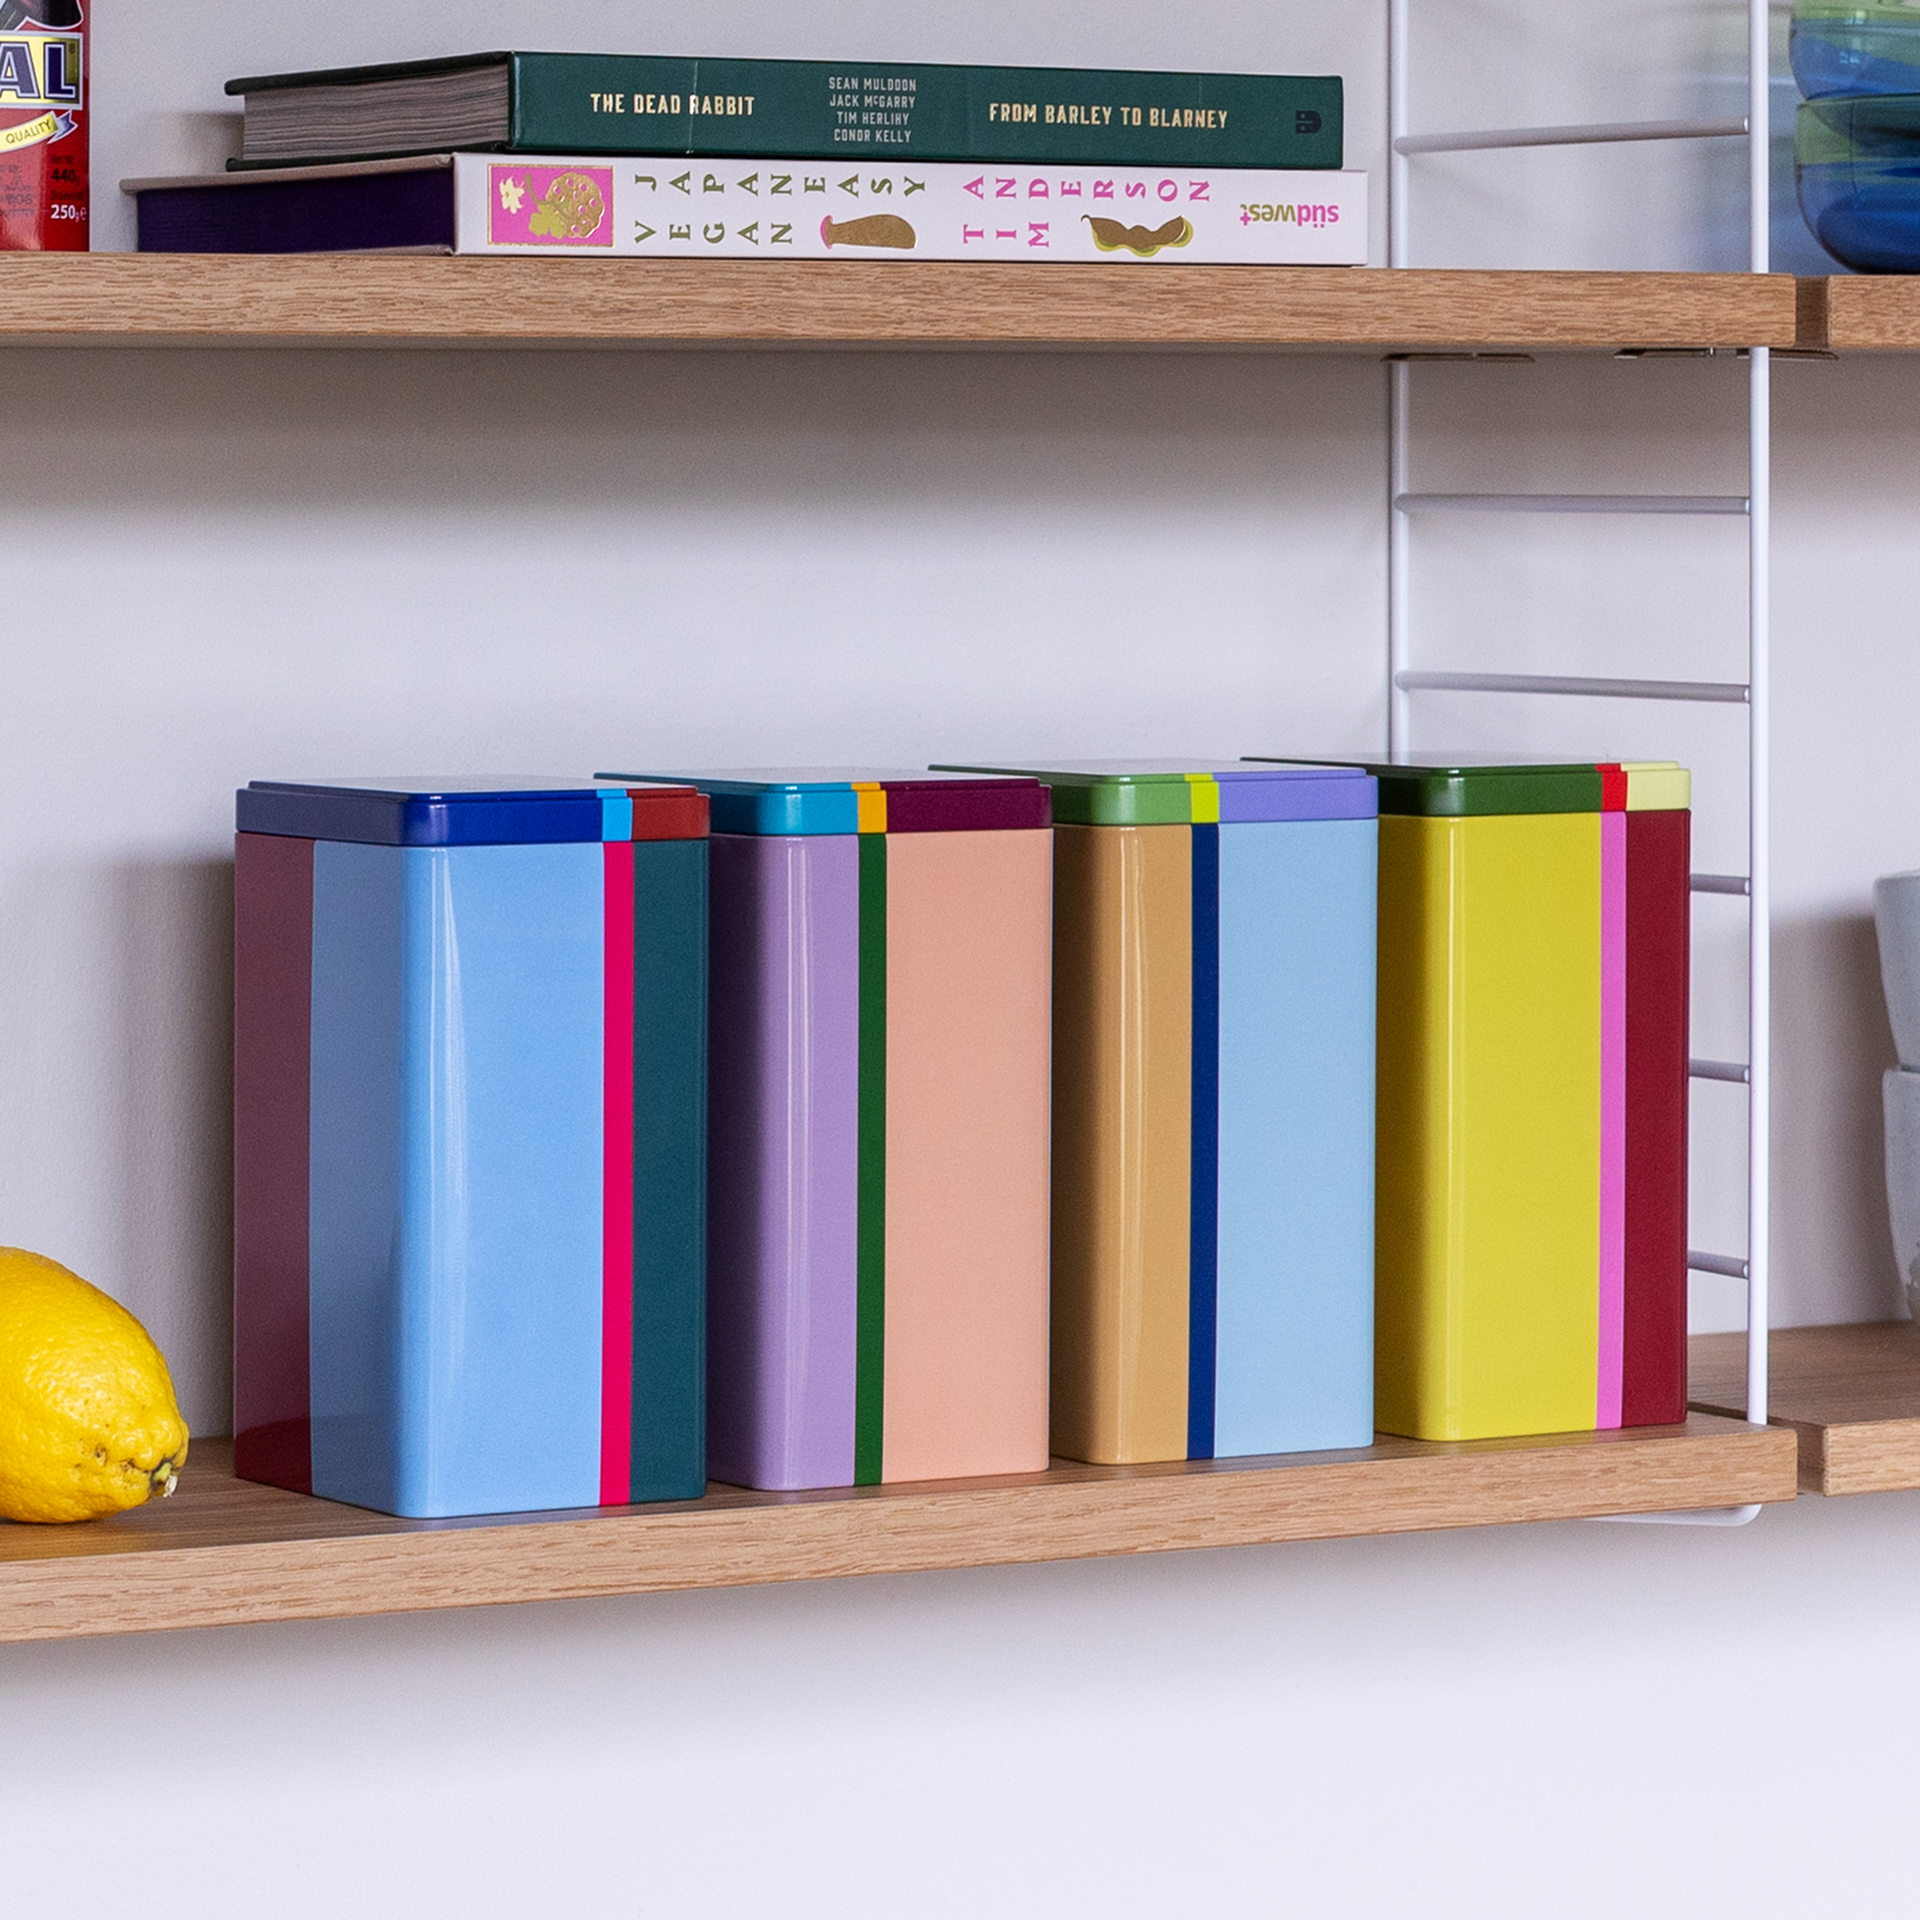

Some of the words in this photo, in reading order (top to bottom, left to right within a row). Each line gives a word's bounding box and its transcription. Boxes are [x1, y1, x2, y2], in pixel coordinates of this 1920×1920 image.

[828, 77, 859, 90] SEAN
[863, 78, 917, 91] MULDOON
[590, 93, 625, 113] THE
[634, 94, 681, 114] DEAD
[689, 95, 755, 116] RABBIT
[829, 94, 860, 107] JACK
[836, 111, 857, 124] TIM
[862, 112, 910, 125] HERLIHY
[989, 103, 1037, 123] FROM
[1044, 105, 1112, 125] BARLEY
[1120, 107, 1142, 126] TO
[1149, 108, 1228, 128] BLARNEY
[5, 118, 51, 144] QUALITY
[833, 128, 871, 141] CONOR
[875, 130, 912, 143] KELLY
[963, 176, 1210, 202] ANDERSON
[1240, 204, 1339, 228] südwest
[634, 220, 793, 245] VEGAN
[963, 222, 1049, 248] TIM
